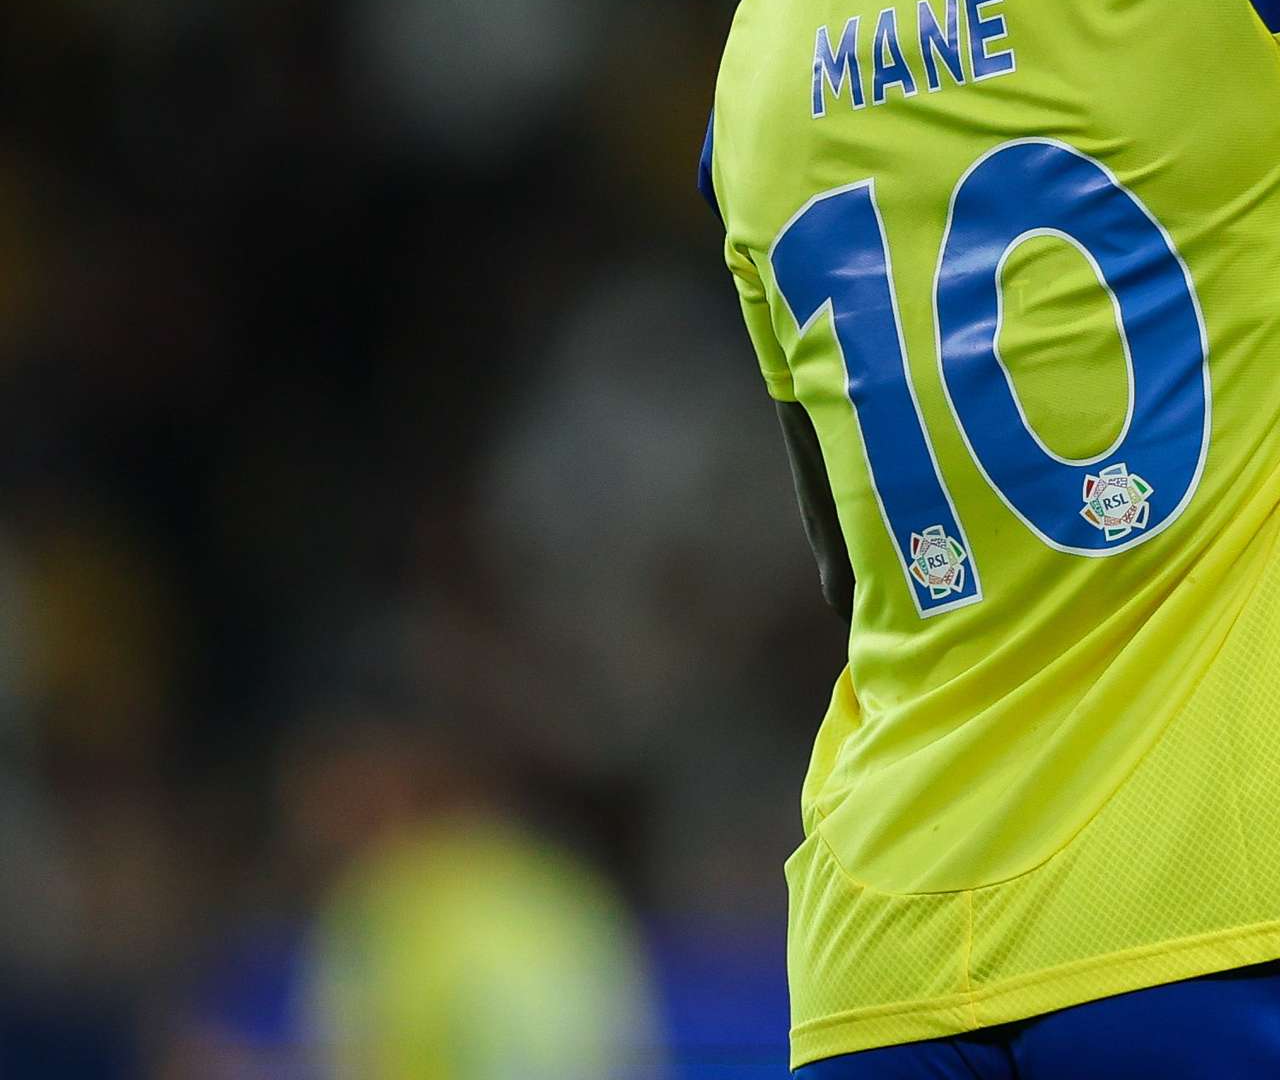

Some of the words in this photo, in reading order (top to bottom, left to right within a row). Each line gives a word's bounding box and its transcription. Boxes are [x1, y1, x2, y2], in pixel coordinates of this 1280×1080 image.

[770, 136, 1211, 618] 10
[1103, 493, 1129, 510] RSL
[928, 553, 949, 569] RSL
